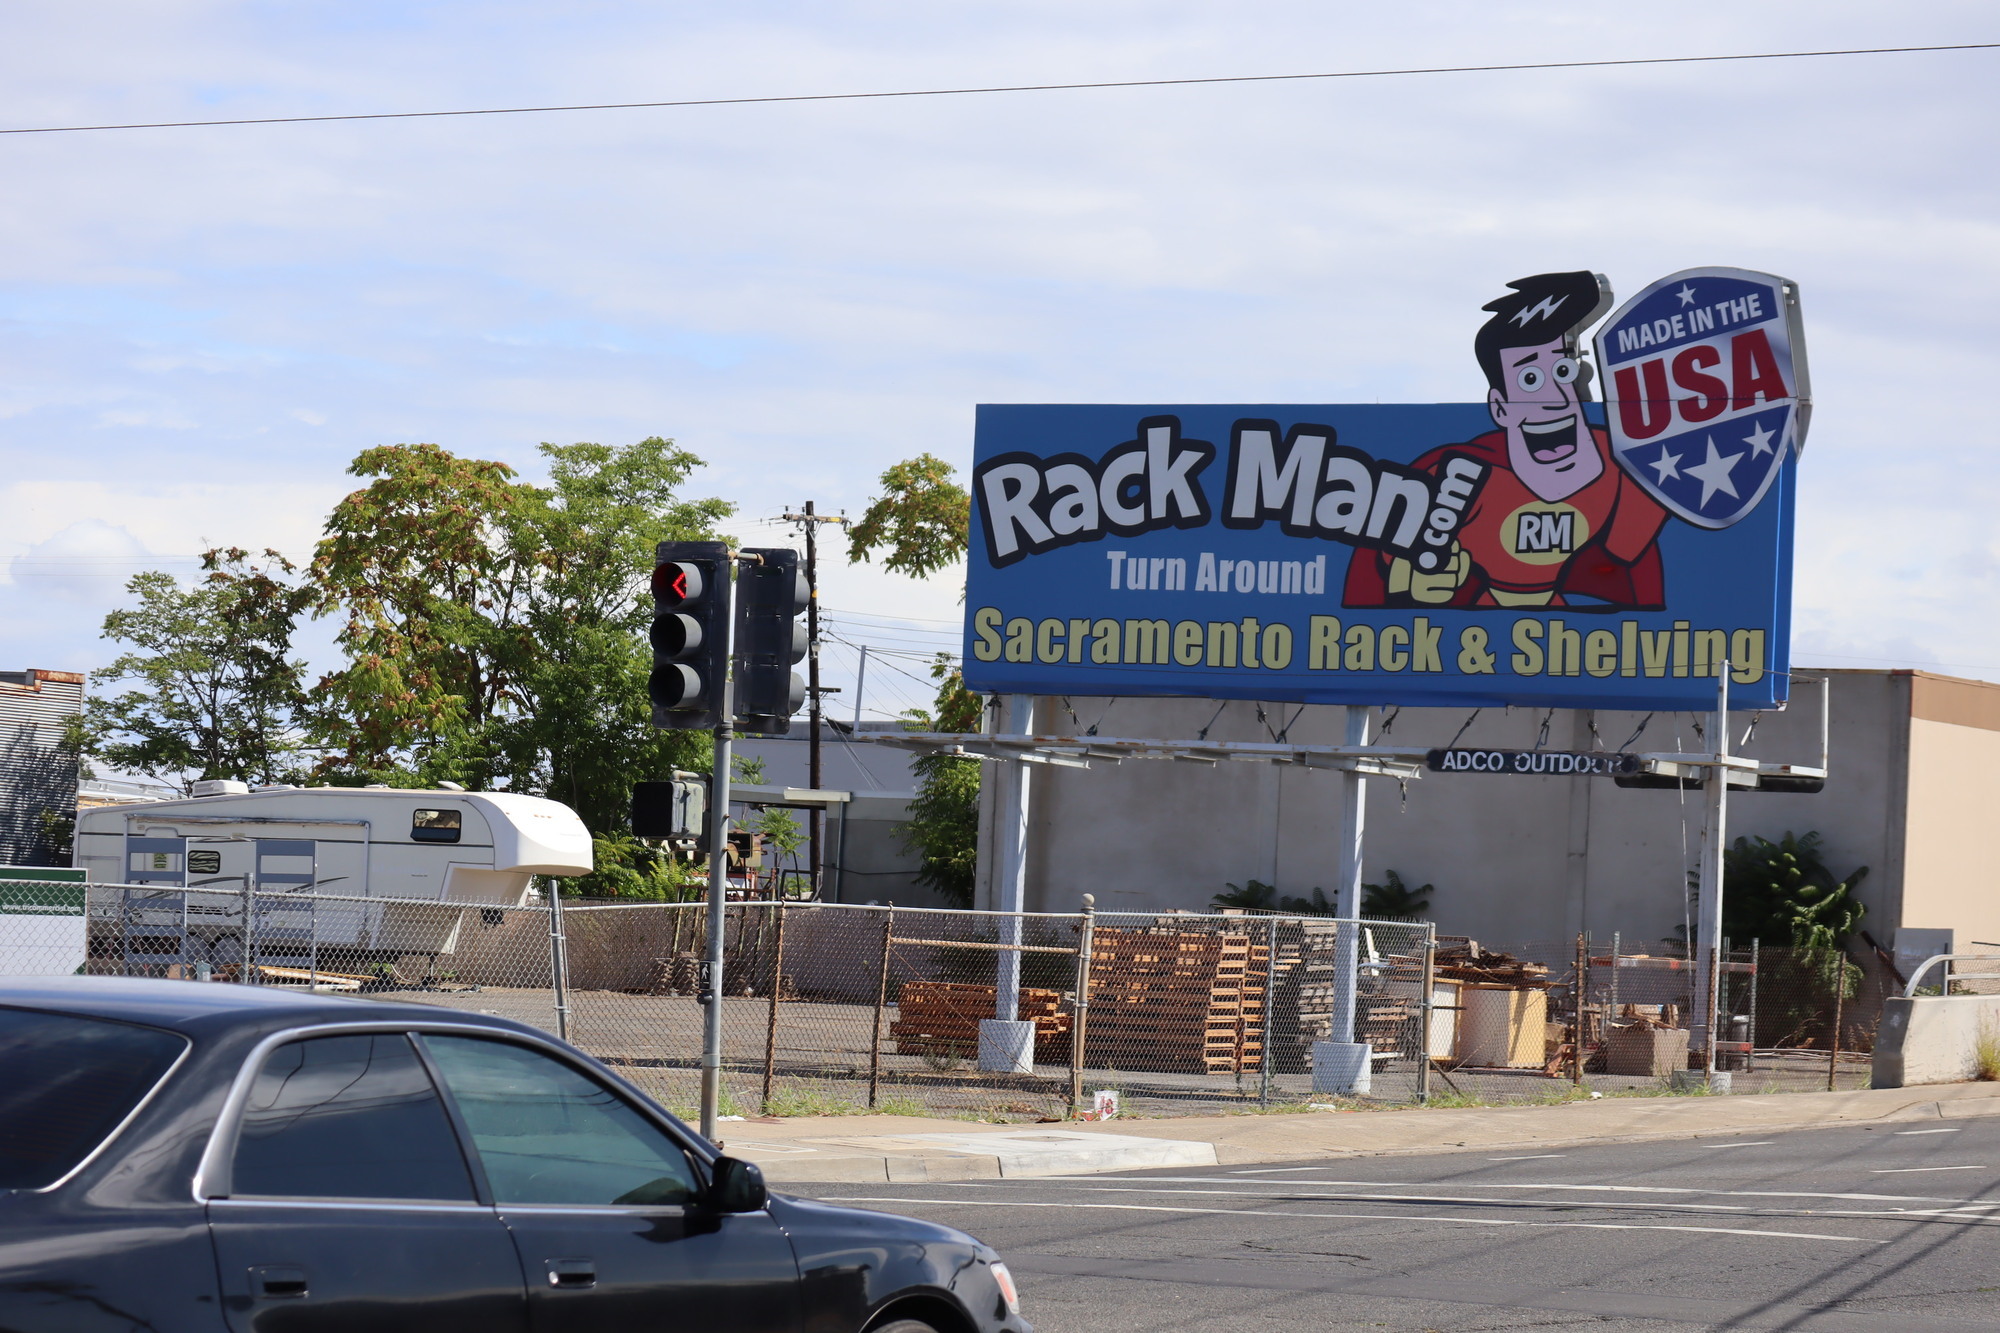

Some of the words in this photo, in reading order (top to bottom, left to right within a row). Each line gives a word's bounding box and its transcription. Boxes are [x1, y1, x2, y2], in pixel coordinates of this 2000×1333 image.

[1618, 314, 1686, 353] MADE
[1688, 308, 1714, 334] IN
[1715, 293, 1762, 326] THE
[1614, 328, 1788, 440] USA
[981, 426, 1206, 558] Rack
[1517, 514, 1572, 551] RM
[1106, 550, 1186, 591] Turn
[1194, 552, 1326, 595] Around
[973, 606, 1294, 671] Sacramento
[1307, 614, 1443, 673] Rack
[1456, 625, 1496, 675] &
[1511, 617, 1765, 684] Shelving
[1441, 750, 1504, 772] ADCO
